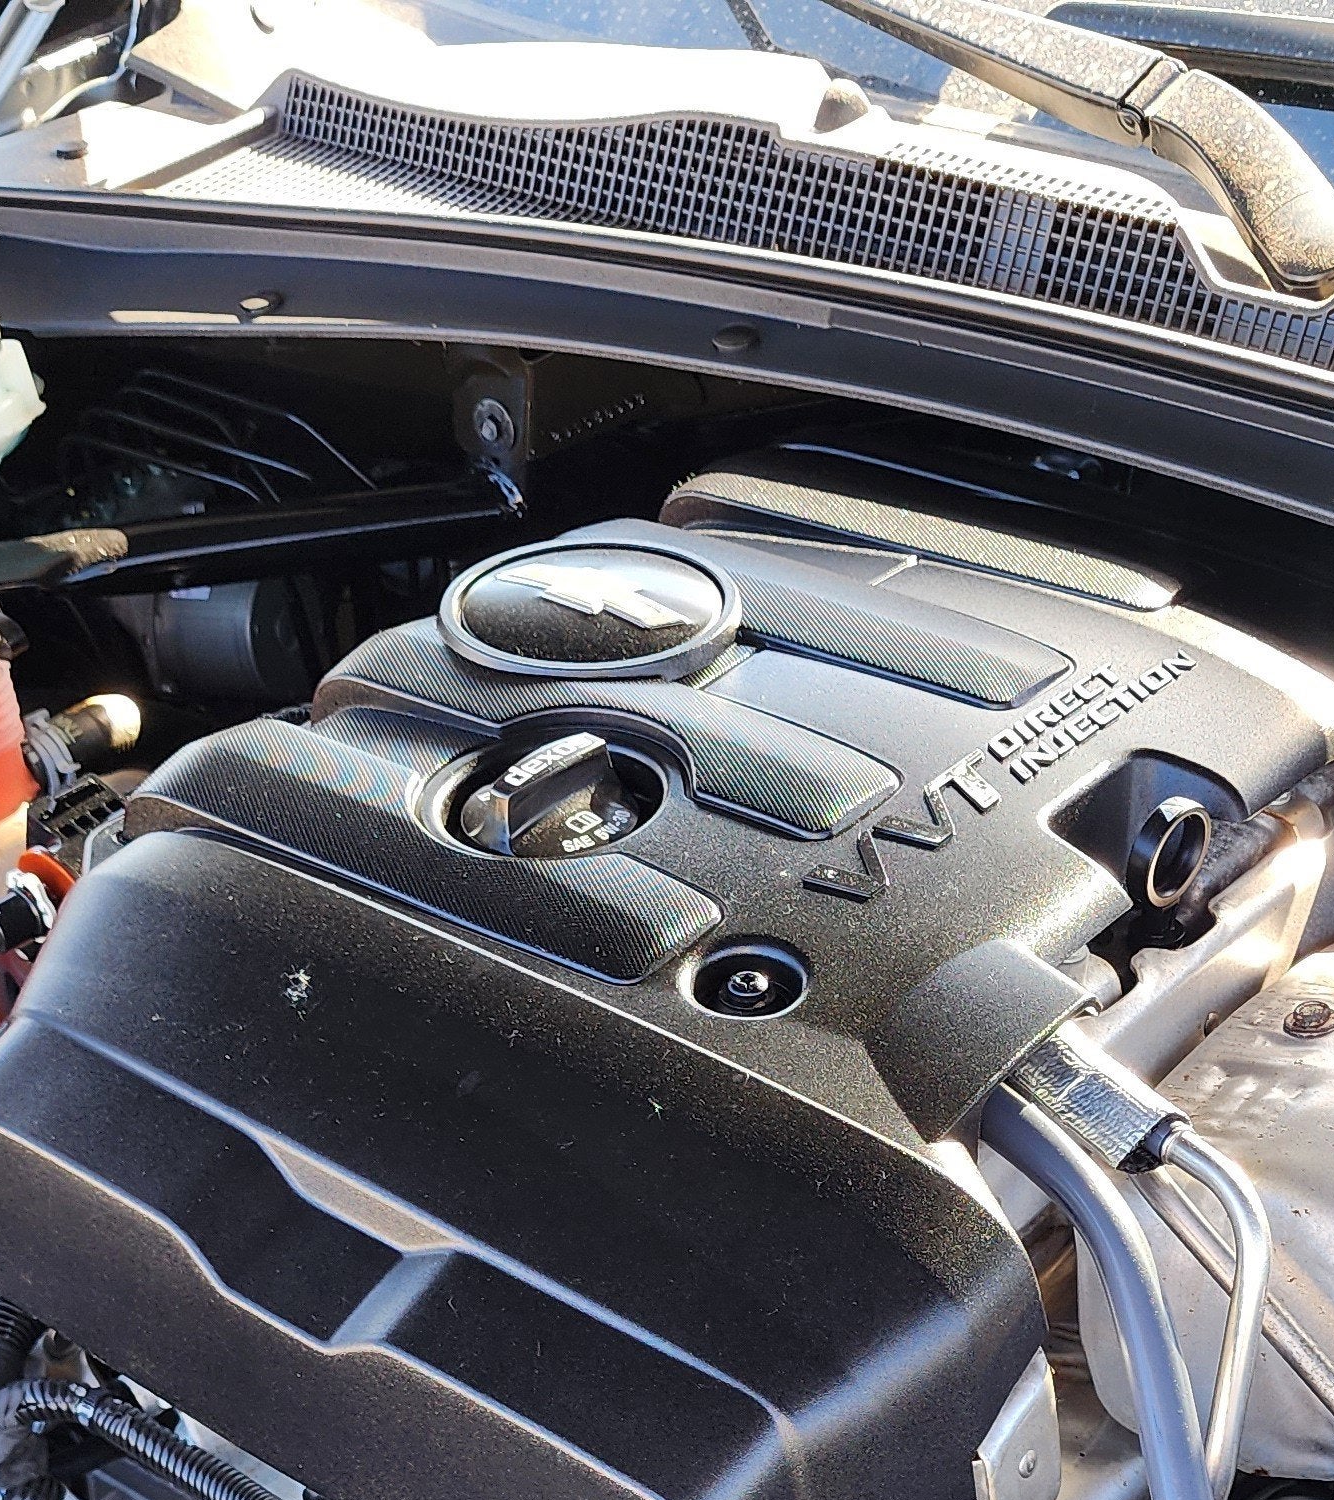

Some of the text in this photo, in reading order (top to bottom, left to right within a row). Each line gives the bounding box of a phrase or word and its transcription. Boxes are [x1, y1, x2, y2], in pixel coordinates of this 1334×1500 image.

[504, 732, 599, 787] dexo
[987, 661, 1122, 763] DIRECT
[1009, 650, 1199, 785] INJECTION
[561, 810, 632, 853] SAE 5W-30
[803, 747, 1002, 900] VVT
